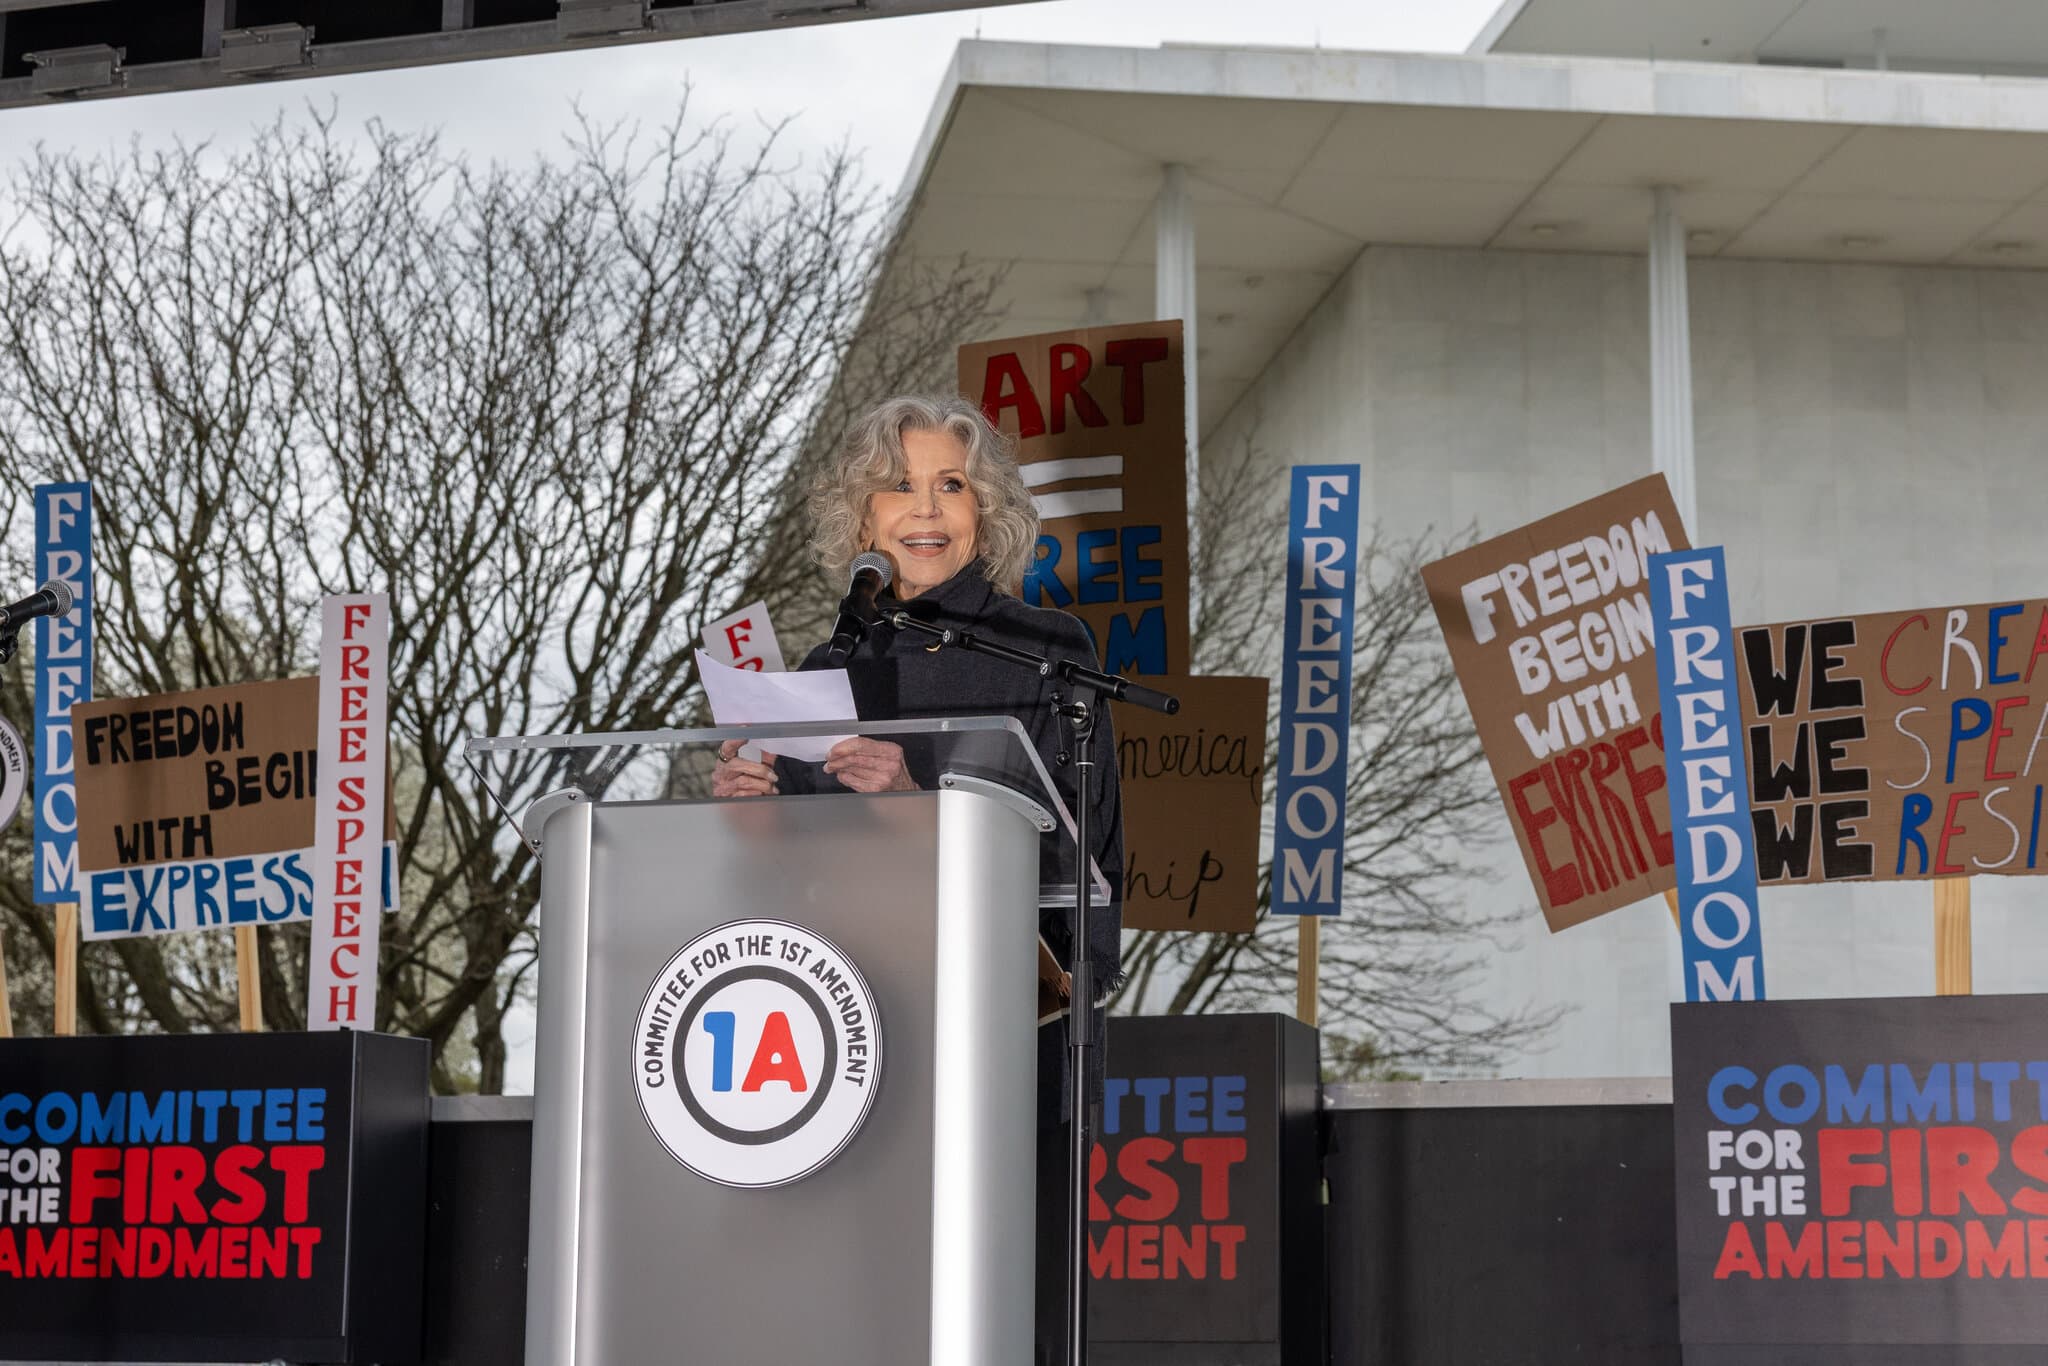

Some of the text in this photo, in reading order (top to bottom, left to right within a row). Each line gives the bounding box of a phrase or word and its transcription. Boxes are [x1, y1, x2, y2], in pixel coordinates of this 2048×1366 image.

[981, 337, 1169, 439] ART
[1023, 525, 1164, 609] REE
[1461, 510, 1672, 645] FREEDOM
[42, 492, 83, 893] FREEDOM
[1282, 475, 1350, 904] FREEDOM
[1742, 619, 1865, 718] WE
[85, 702, 245, 765] FREEDOM
[1514, 672, 1642, 759] WITH
[1117, 728, 1260, 806] merica,
[1666, 559, 1755, 1001] FREEDOM
[1750, 716, 1872, 803] WE
[115, 815, 213, 864] WITH
[328, 604, 372, 1022] FREE SPEECH
[1508, 712, 1675, 907] EXPRE
[1751, 799, 1875, 884] WE
[91, 846, 391, 933] EXPRESS
[645, 935, 868, 1088] COMMITTEE FOR THE 1ST AMENDMENT
[703, 1011, 807, 1092] 1A
[0, 1088, 326, 1144] COMMITTEE
[1708, 1129, 1805, 1170] FOR
[69, 1145, 325, 1224] FIRST
[1709, 1175, 1807, 1216] THE
[0, 1227, 321, 1278] AMENDMENT
